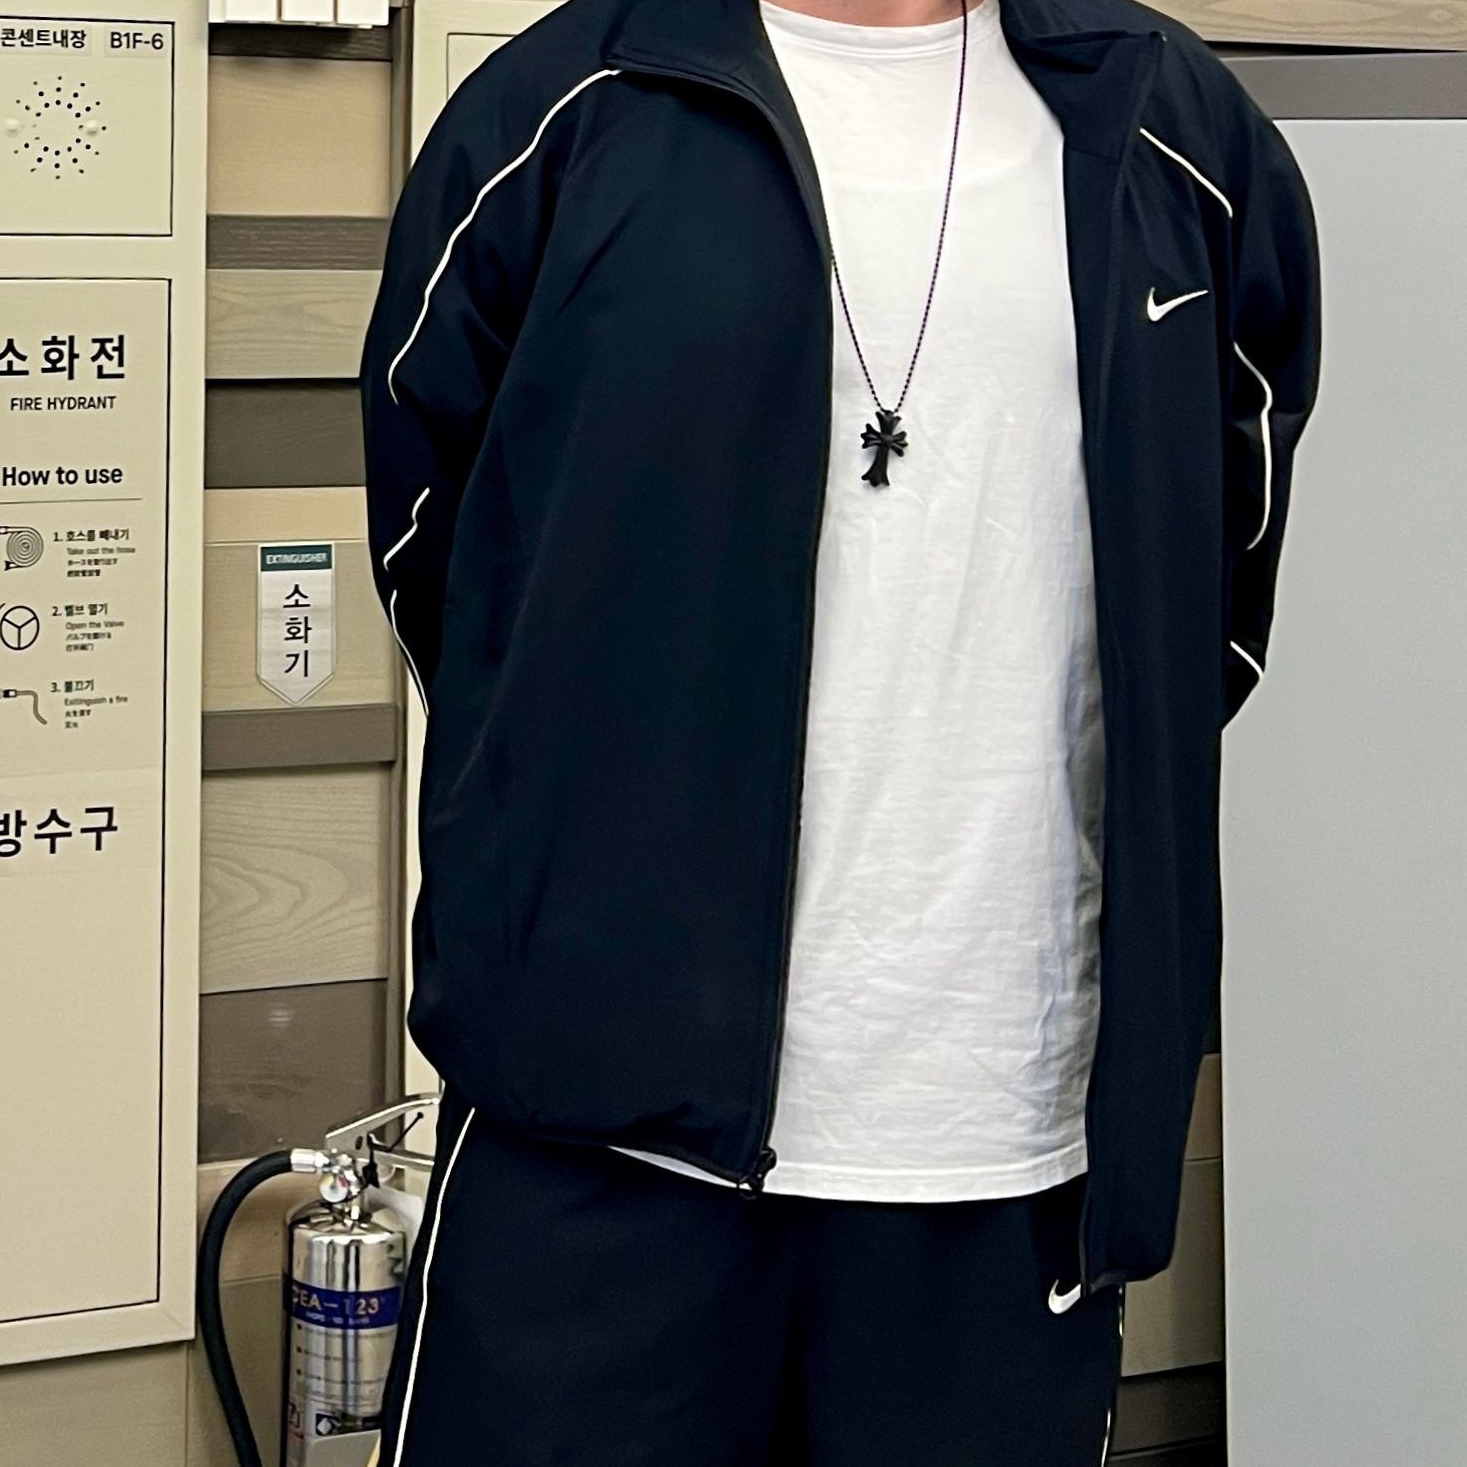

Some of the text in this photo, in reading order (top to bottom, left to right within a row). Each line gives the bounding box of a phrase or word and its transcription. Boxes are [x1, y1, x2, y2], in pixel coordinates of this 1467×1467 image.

[109, 31, 164, 50] B1F-6
[10, 395, 117, 411] FIRE HYDRANT
[2, 466, 123, 486] How to use
[282, 583, 312, 678] 소화기
